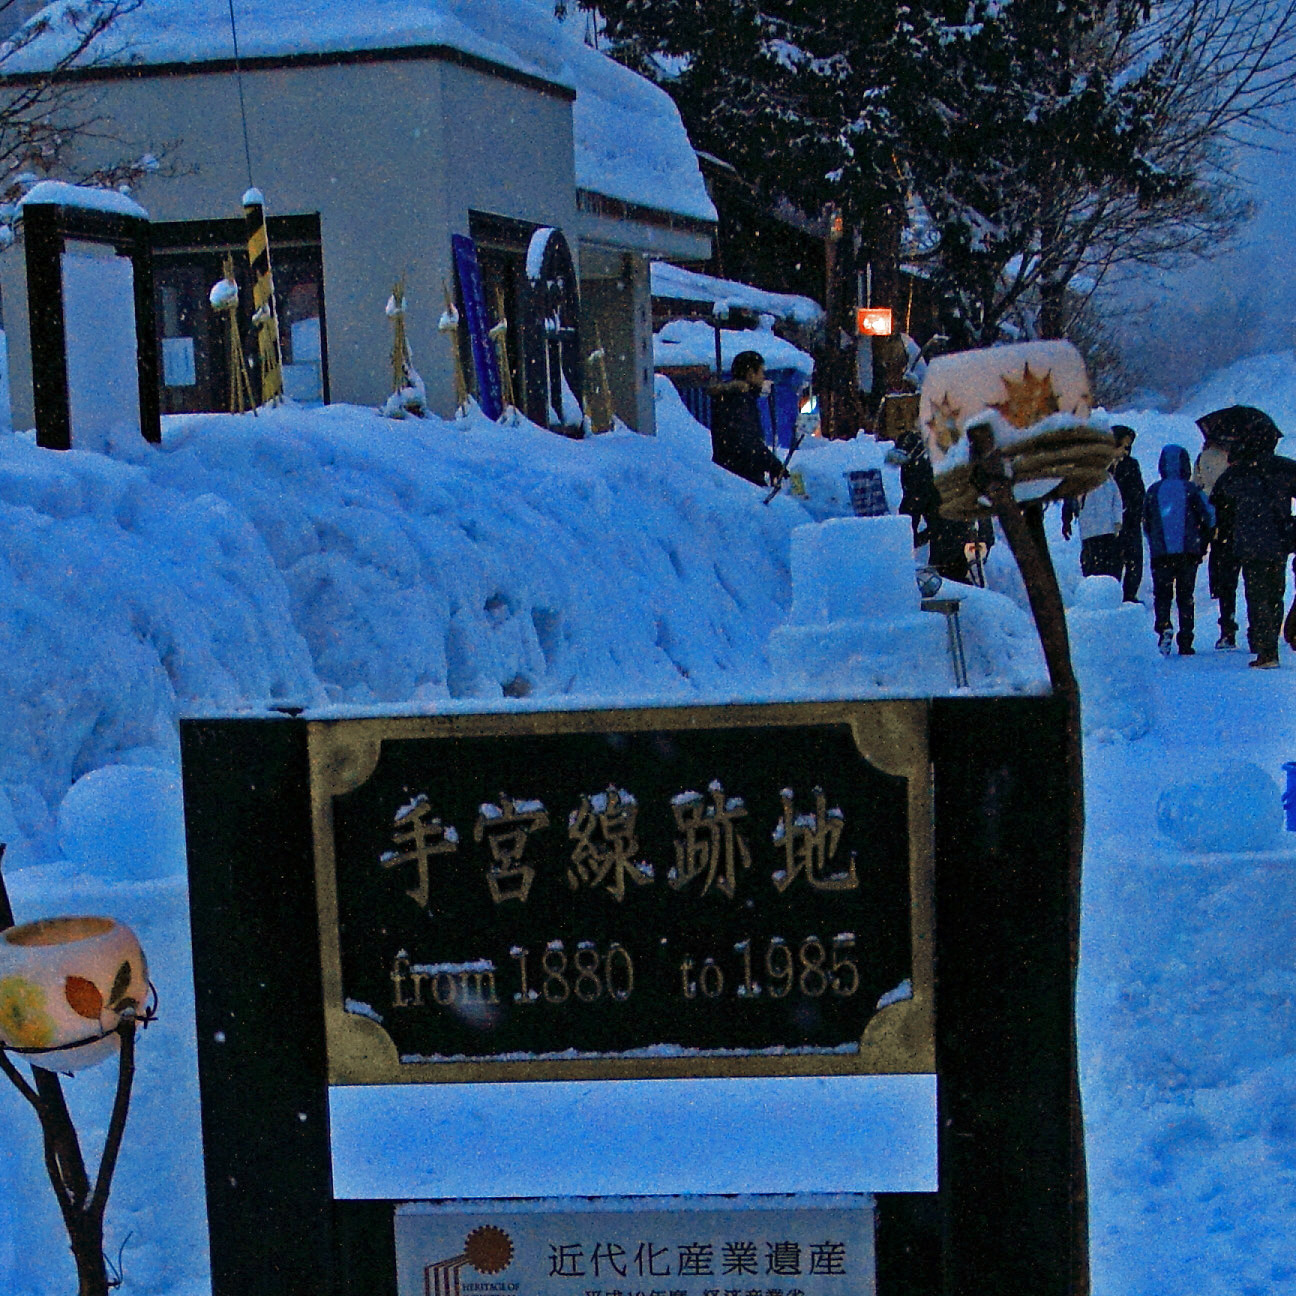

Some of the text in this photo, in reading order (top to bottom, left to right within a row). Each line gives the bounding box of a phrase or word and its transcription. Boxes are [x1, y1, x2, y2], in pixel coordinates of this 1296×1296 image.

[380, 781, 860, 907] 手宮線跡地
[391, 933, 860, 1008] from 1880 to 1985
[548, 1240, 847, 1278] 近代化産業遺産
[462, 1283, 520, 1292] HERITAGE OF
